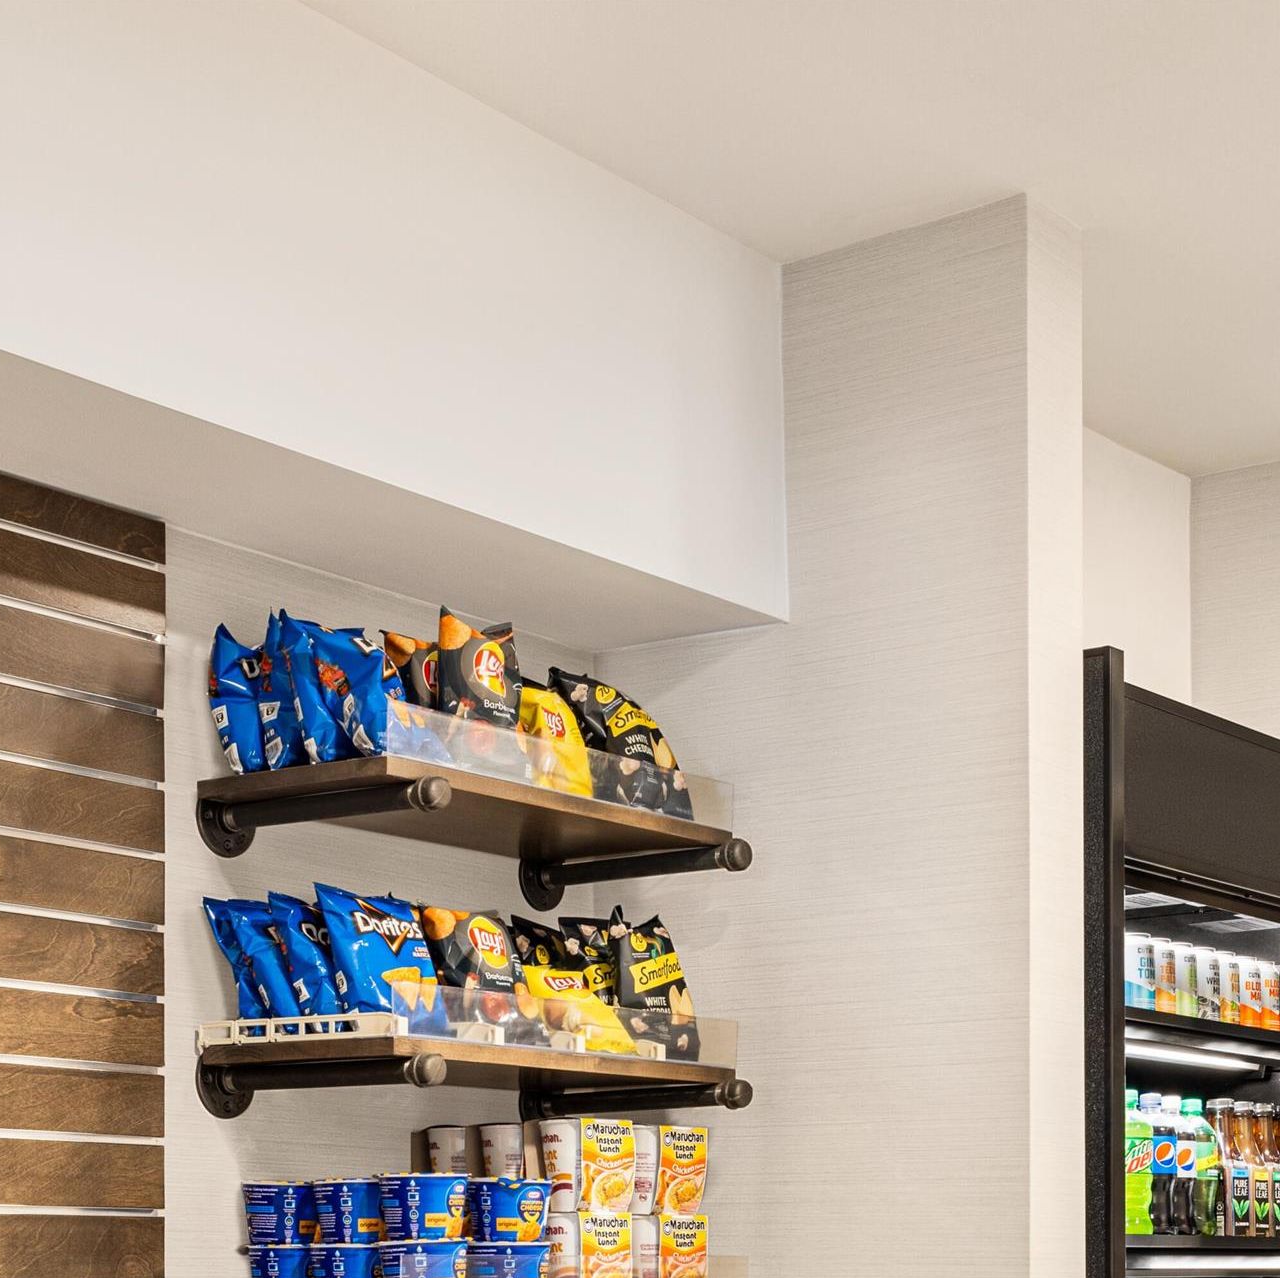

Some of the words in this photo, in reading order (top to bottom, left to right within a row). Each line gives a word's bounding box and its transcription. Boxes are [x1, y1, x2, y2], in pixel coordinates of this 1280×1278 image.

[352, 910, 424, 940] Doritos
[1138, 968, 1155, 979] TON
[645, 996, 667, 1007] WHITE
[593, 1123, 631, 1136] Maruchan
[596, 1136, 622, 1145] Instant
[670, 1131, 704, 1143] Maruchan
[600, 1145, 620, 1153] Lunch
[673, 1144, 696, 1153] Instant
[675, 1152, 694, 1160] Lunch
[1234, 1179, 1248, 1187] PURE
[1255, 1182, 1268, 1191] PURE
[1234, 1186, 1249, 1197] LEAF
[1255, 1190, 1269, 1199] LEAF
[590, 1217, 629, 1229] Maruchan
[670, 1220, 705, 1231] Maruchan
[594, 1229, 620, 1239] Instant
[673, 1231, 697, 1240] Instant
[598, 1237, 618, 1246] Lunch
